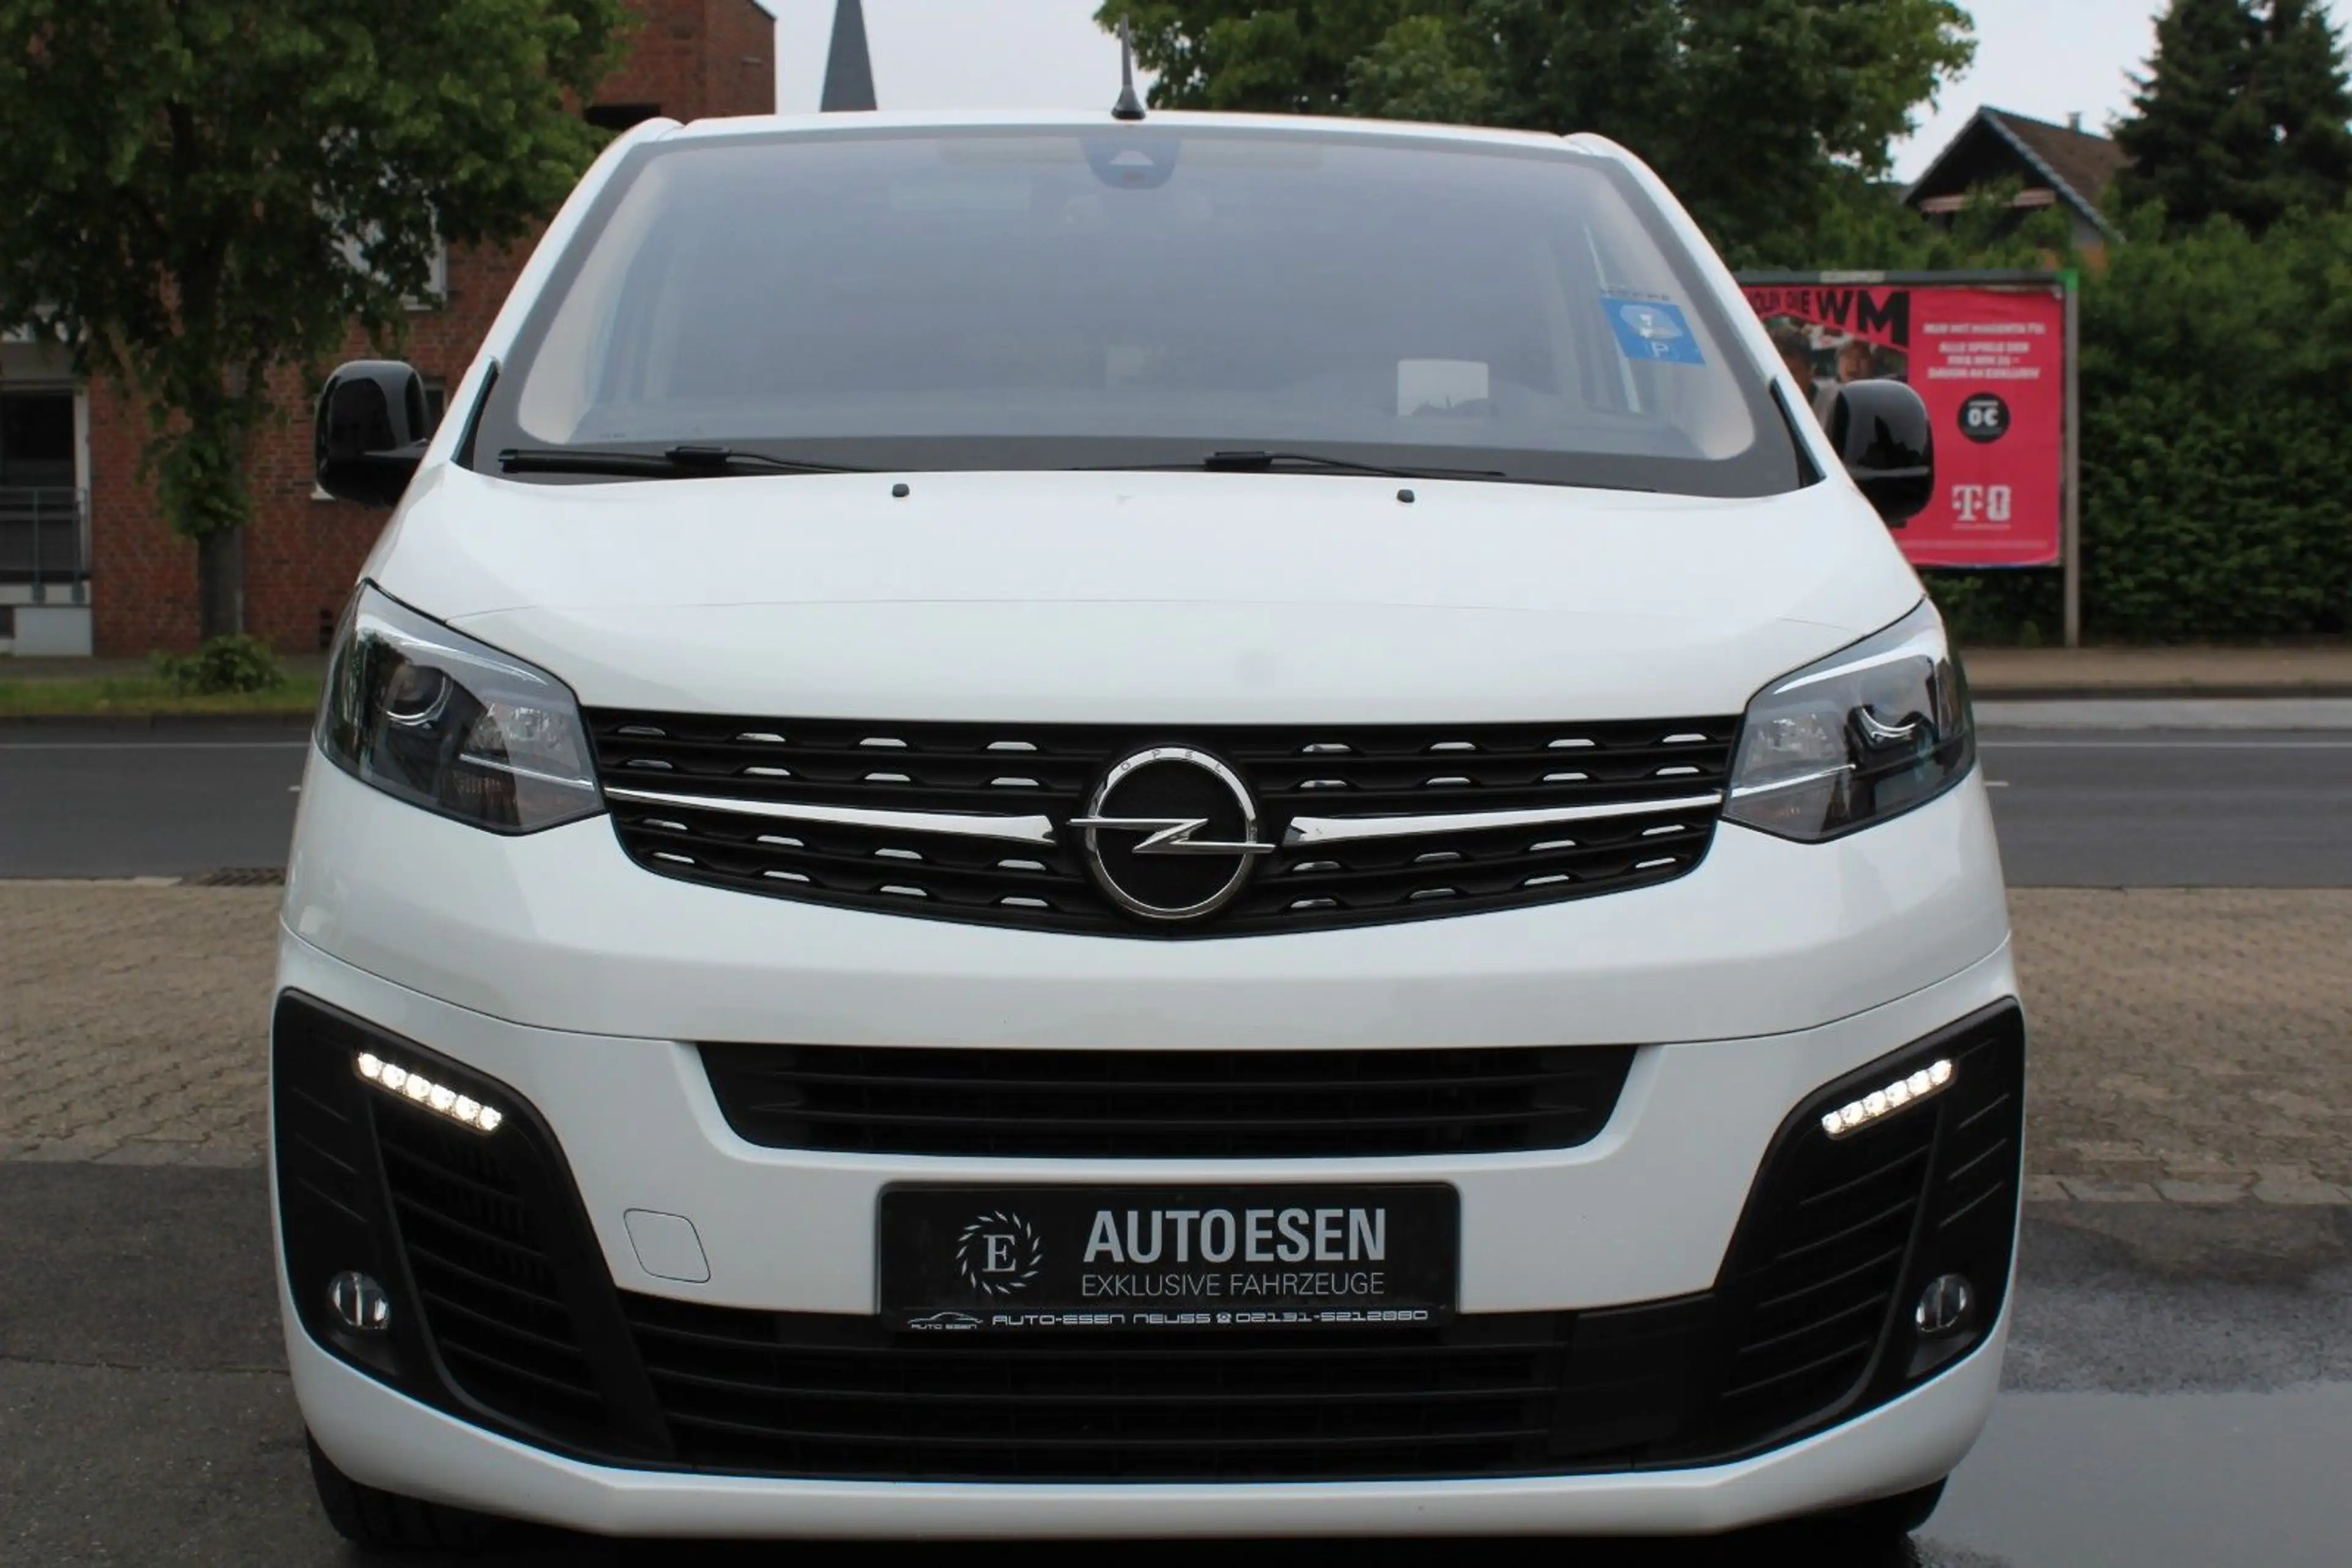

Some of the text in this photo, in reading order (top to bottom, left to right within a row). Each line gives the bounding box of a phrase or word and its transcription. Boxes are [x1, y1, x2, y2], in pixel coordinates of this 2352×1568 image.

[1815, 290, 1910, 347] WM
[1120, 747, 1222, 774] OPEL
[982, 1234, 1017, 1272] E
[1082, 1272, 1385, 1297] EXKLUSIVE FAHRZEUGE
[992, 1313, 1126, 1326] AUTO-ESEN
[1133, 1313, 1211, 1325] NEUSS
